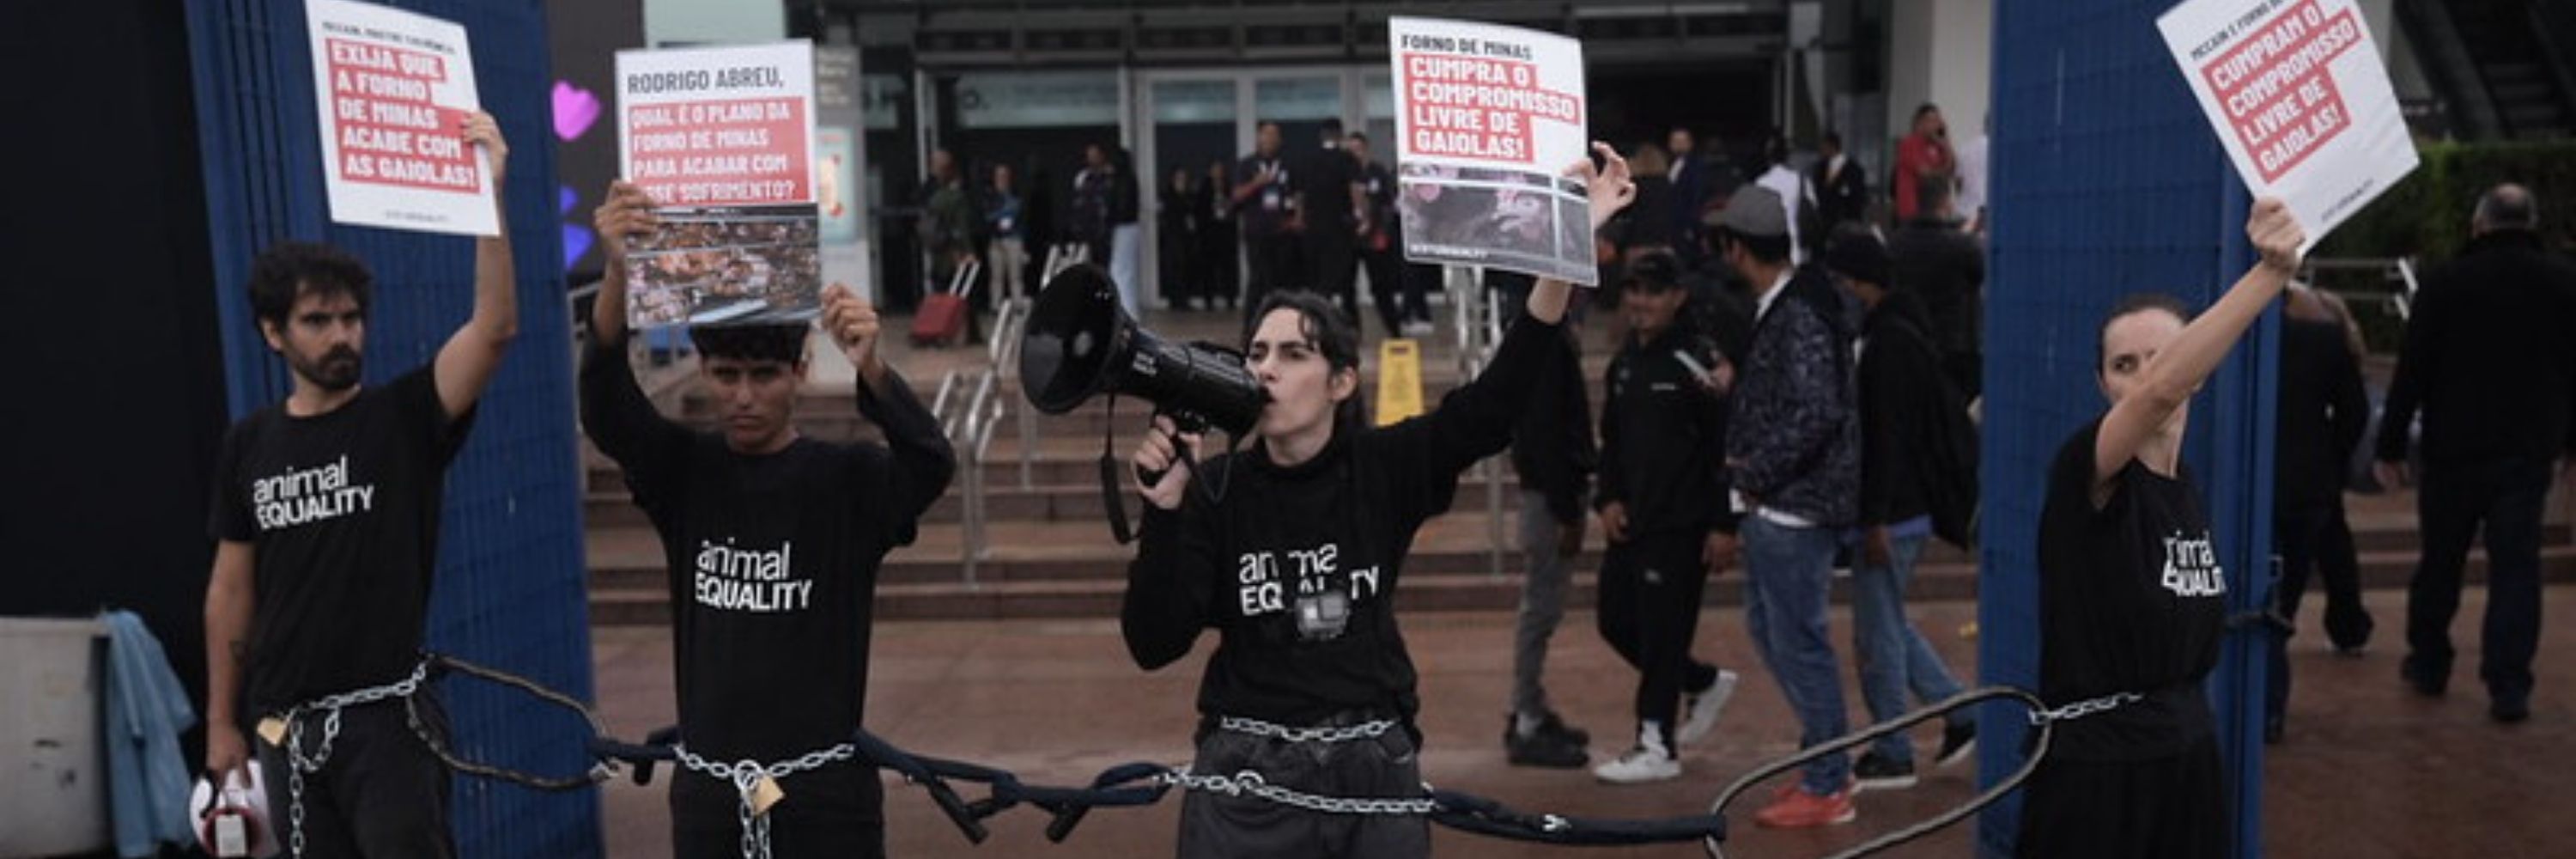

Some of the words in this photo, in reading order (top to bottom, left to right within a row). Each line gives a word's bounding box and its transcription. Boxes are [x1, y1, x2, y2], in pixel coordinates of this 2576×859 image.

[334, 43, 396, 70] EXIJA
[398, 53, 442, 78] QUE
[1400, 34, 1455, 52] FORNO
[1459, 39, 1478, 55] DE
[1484, 40, 1534, 61] MINAS
[2211, 13, 2306, 90] CUMPRAM
[2302, 4, 2320, 27] O
[628, 70, 710, 94] RODRIGO
[715, 66, 784, 89] ABREU,
[1410, 57, 1508, 84] CUMPRA
[1512, 65, 1530, 87] O
[2228, 17, 2356, 118] COMPROMISSO
[337, 70, 351, 91] A
[355, 71, 428, 101] FORNO
[1413, 81, 1576, 119] COMPROMISSO
[338, 98, 368, 121] DE
[373, 102, 440, 129] MINAS
[630, 107, 675, 128] QUAL
[691, 105, 704, 123] O
[708, 102, 764, 123] PLANO
[766, 101, 790, 120] DA
[1414, 106, 1483, 130] LIVRE
[1489, 111, 1521, 134] DE
[2243, 94, 2303, 146] LIVRE
[2298, 75, 2328, 107] DE
[343, 126, 412, 154] ACABE
[418, 136, 462, 160] COM
[634, 132, 686, 152] FORNO
[691, 131, 713, 149] DE
[717, 127, 769, 149] MINAS
[1417, 130, 1525, 159] GAIOLAS!
[2259, 102, 2342, 171] GAIOLAS!
[347, 155, 374, 177] AS
[380, 158, 475, 187] GAIOLAS!
[633, 158, 677, 178] PARA
[682, 155, 748, 175] ACABAR
[753, 154, 787, 173] COM
[679, 180, 795, 201] SOFRIMENTO?
[254, 454, 348, 503] animal
[257, 484, 374, 530] EQUALITY
[697, 537, 790, 581] animal
[695, 571, 812, 611] EQUALITY
